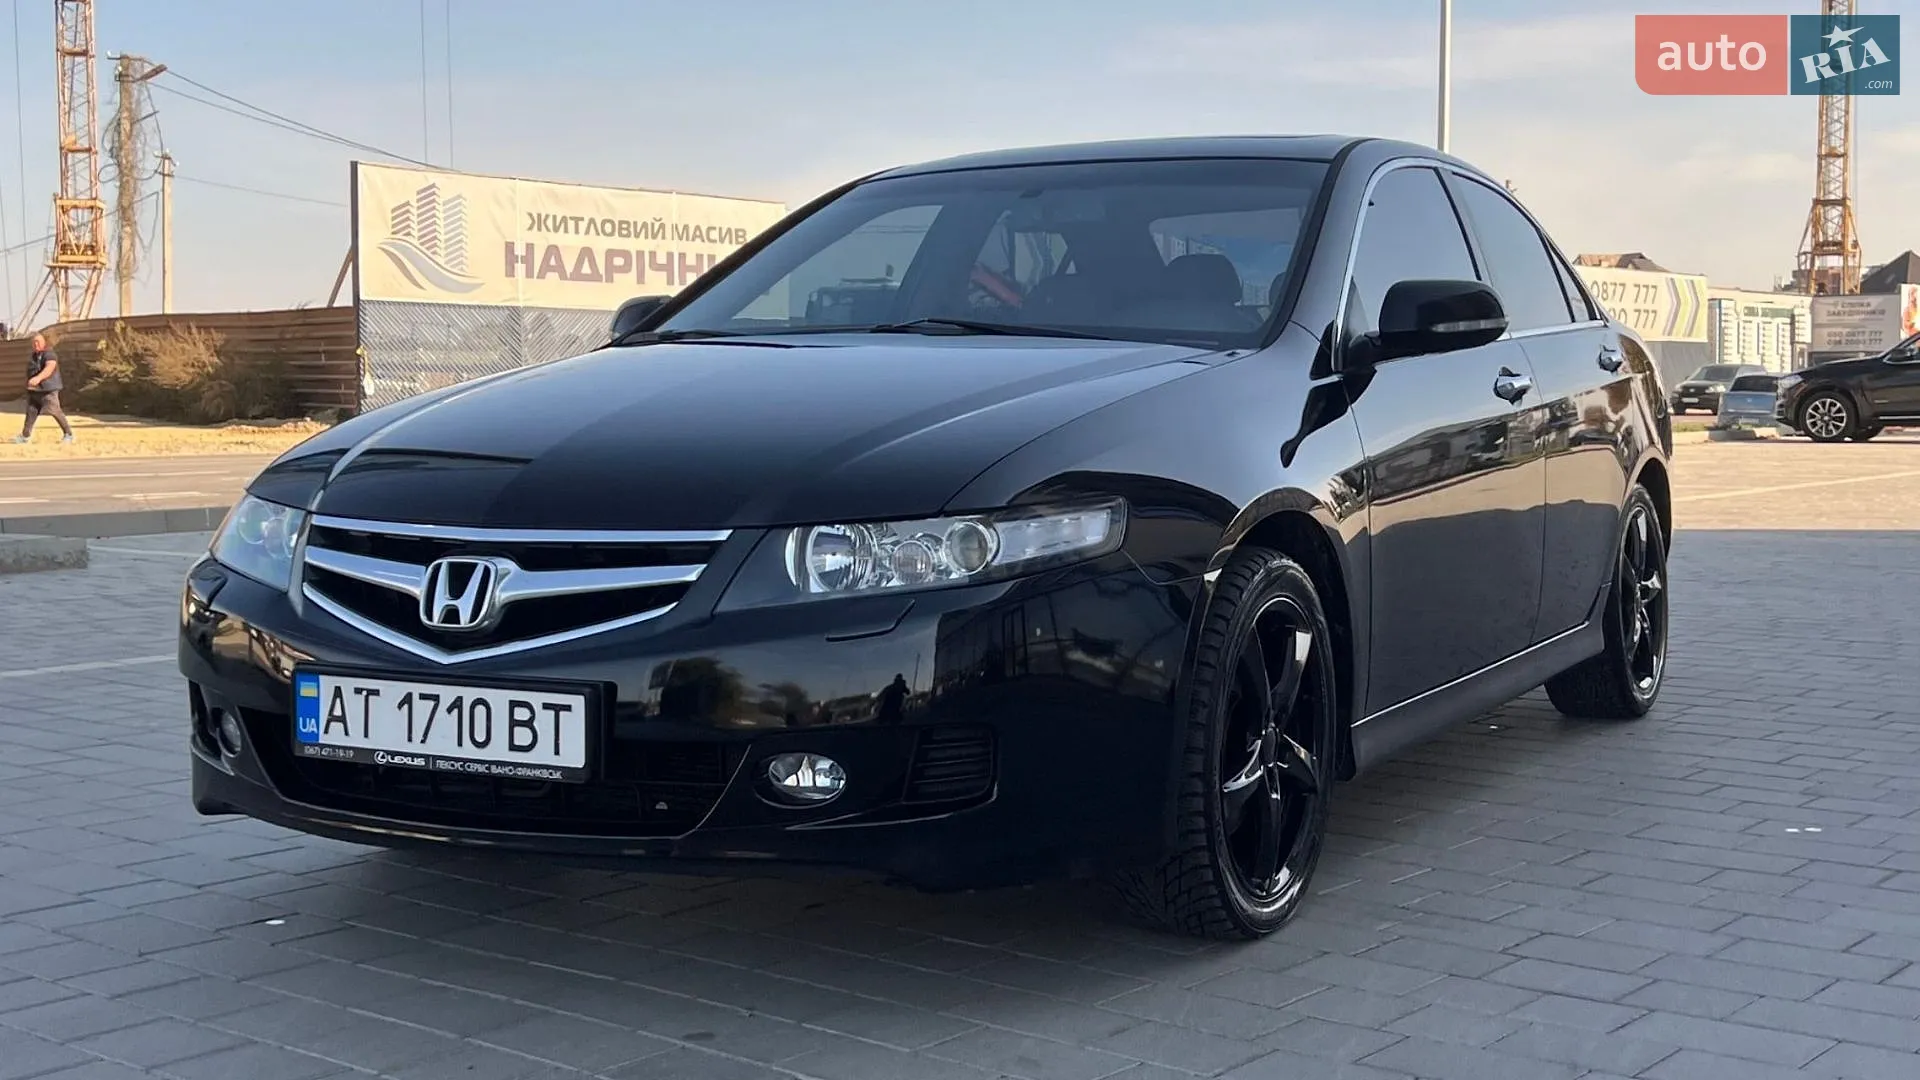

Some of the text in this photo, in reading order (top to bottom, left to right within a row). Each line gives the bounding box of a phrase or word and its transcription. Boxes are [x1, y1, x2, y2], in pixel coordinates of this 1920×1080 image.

[526, 211, 748, 245] ЖИТЛОВИЙ МАСИВ
[1633, 283, 1658, 305] 777
[1633, 309, 1658, 329] 777
[299, 685, 573, 756] UA AT 1710 BT
[387, 755, 426, 766] LEXUS
